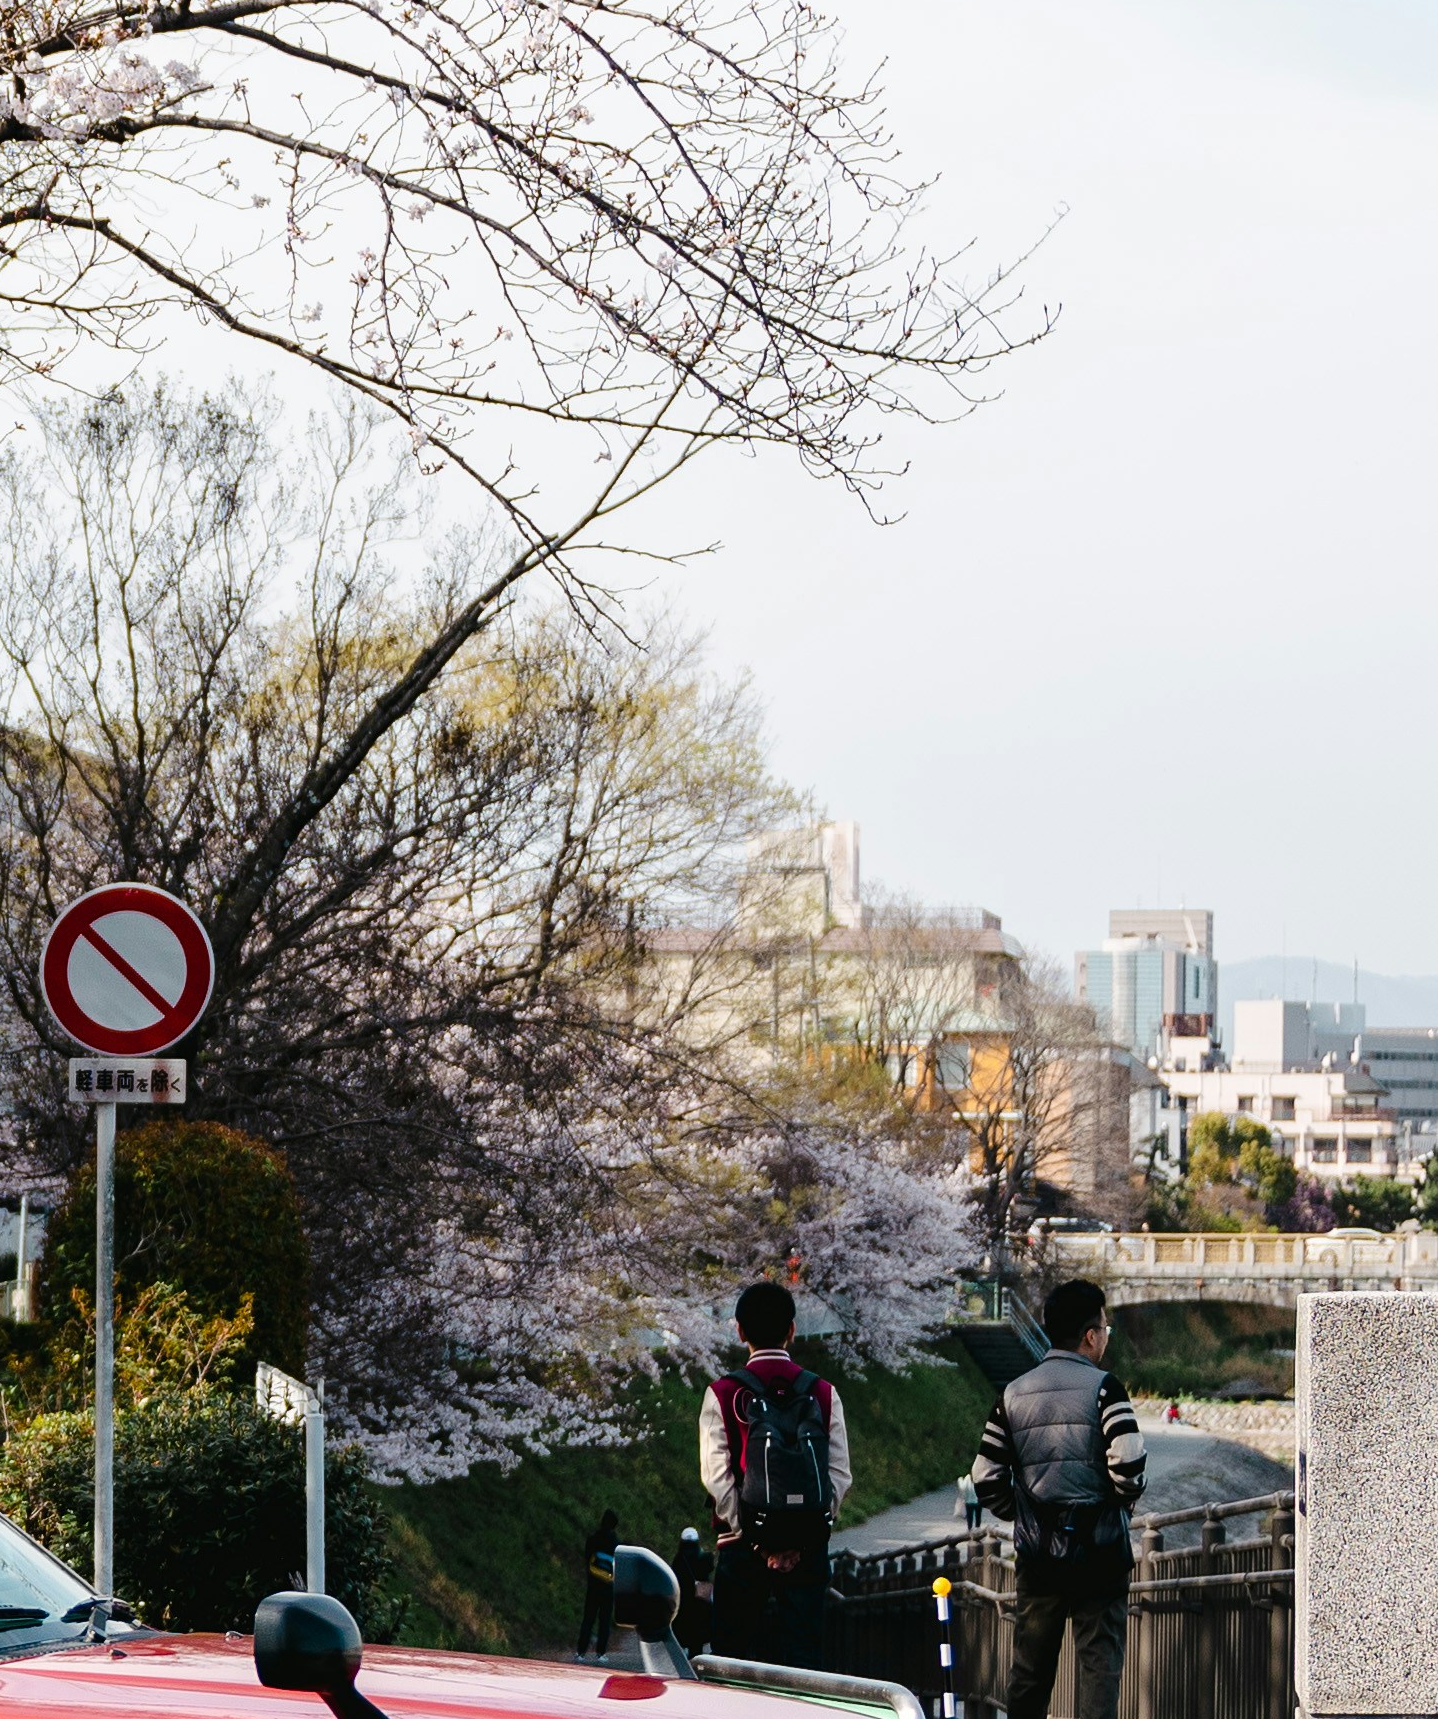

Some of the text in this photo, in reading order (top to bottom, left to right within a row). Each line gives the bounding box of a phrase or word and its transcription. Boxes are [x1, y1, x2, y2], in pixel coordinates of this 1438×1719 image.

[75, 1068, 181, 1093] 軽車両を除く
